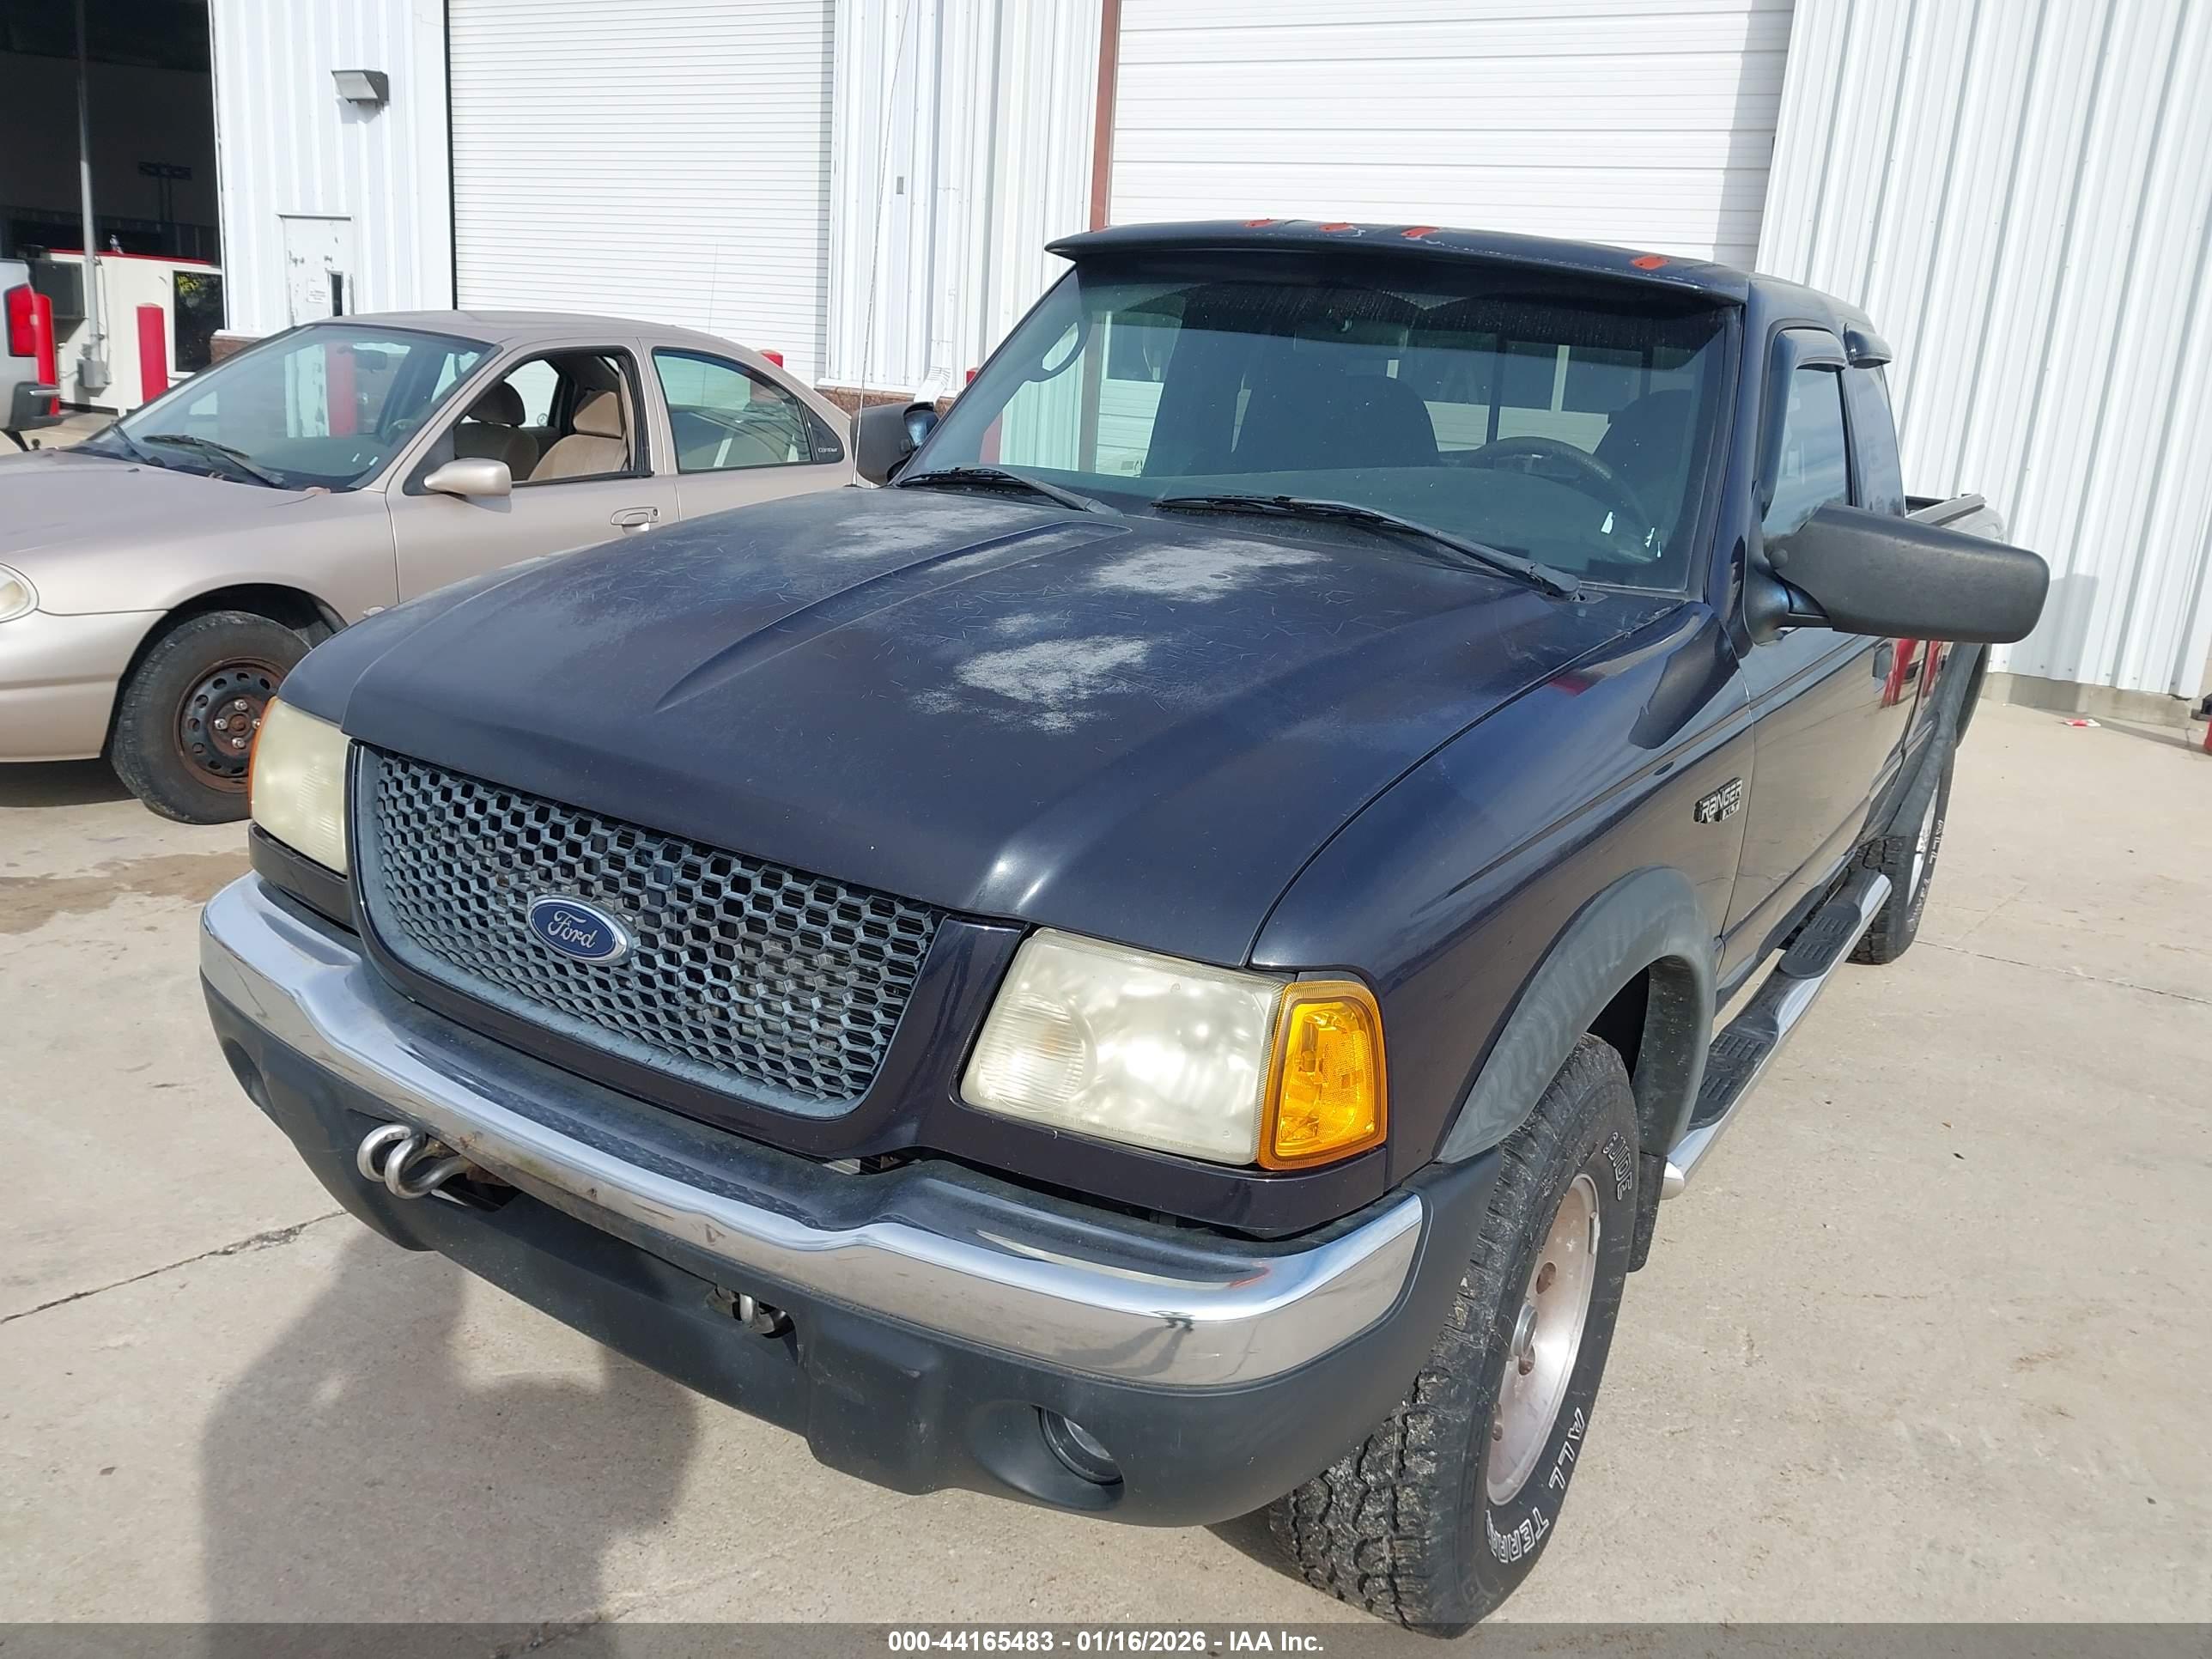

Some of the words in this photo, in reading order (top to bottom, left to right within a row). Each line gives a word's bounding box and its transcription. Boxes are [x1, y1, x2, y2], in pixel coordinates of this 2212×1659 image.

[1700, 780, 1742, 823] RANGER
[1723, 800, 1740, 819] XLT
[548, 910, 599, 949] Ford
[1548, 1407, 1585, 1489] ALL
